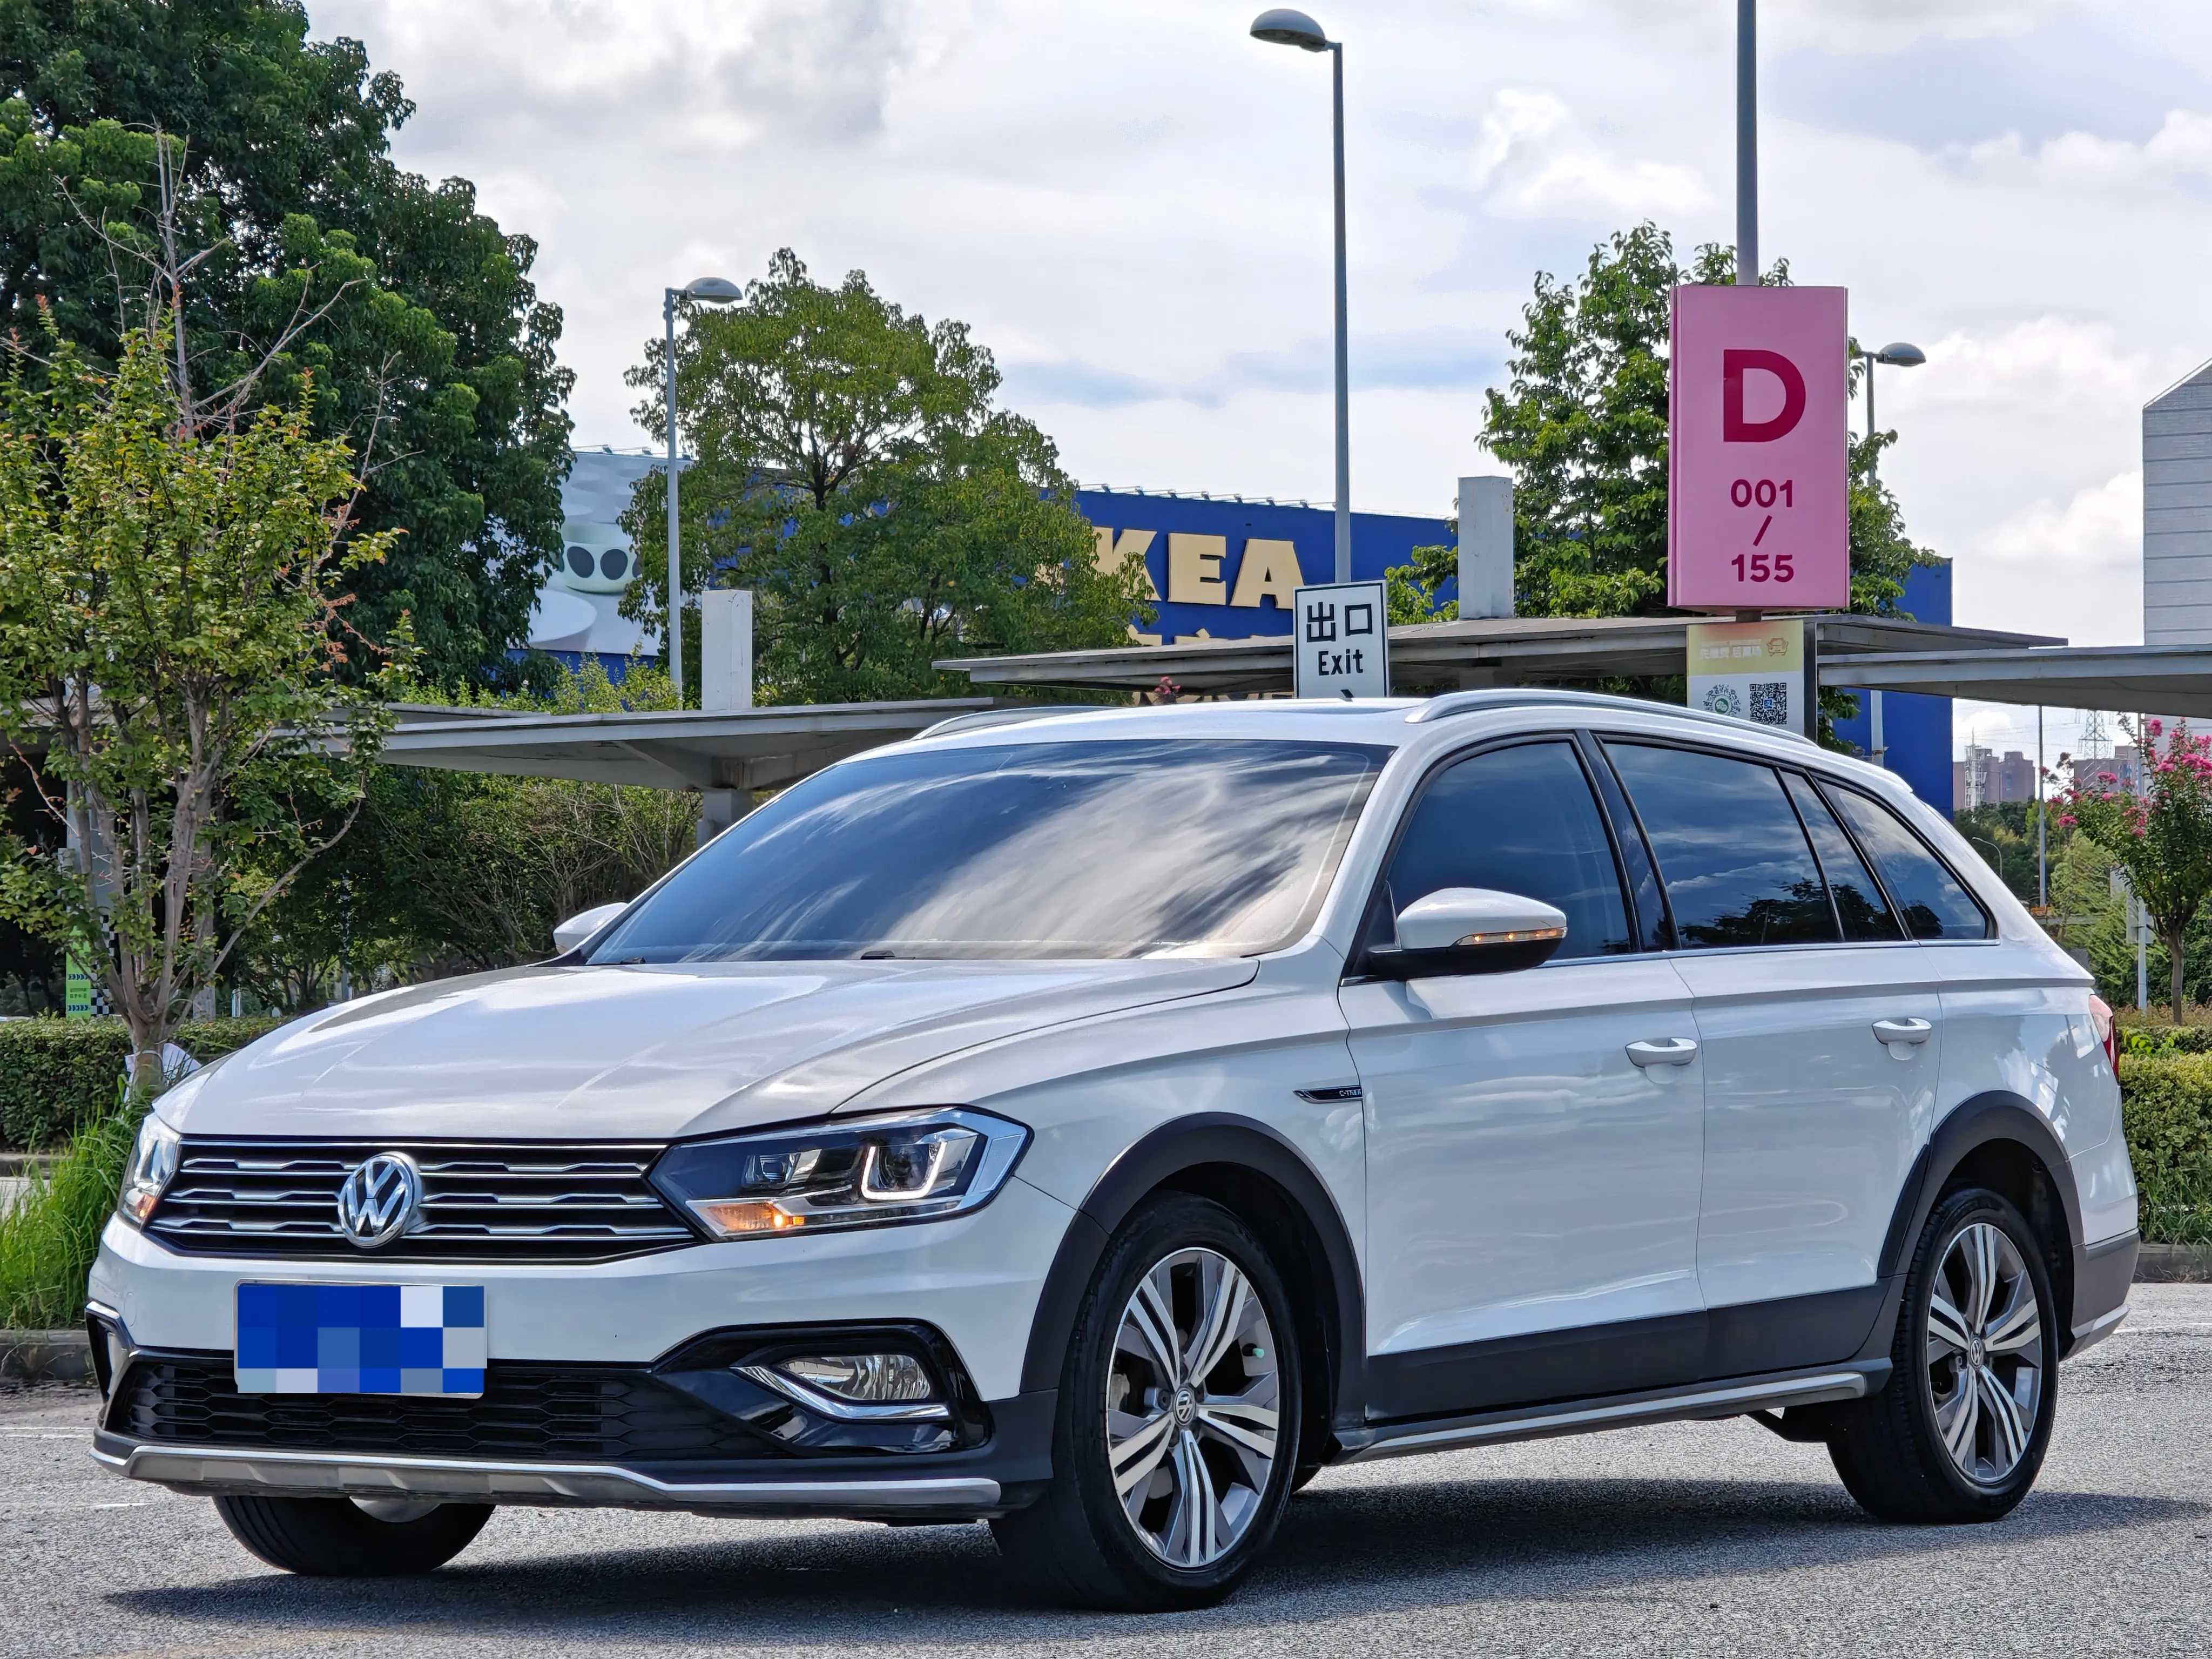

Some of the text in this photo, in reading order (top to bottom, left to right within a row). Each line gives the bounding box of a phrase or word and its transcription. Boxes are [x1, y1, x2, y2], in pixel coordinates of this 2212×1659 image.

[1724, 349, 1806, 442] D
[1731, 479, 1793, 508] 001
[1753, 515, 1772, 546] /
[1034, 526, 1305, 609] KEA
[1731, 554, 1794, 583] 155
[1306, 602, 1372, 643] 出口
[1318, 649, 1364, 676] Exit
[341, 1157, 410, 1244] VW
